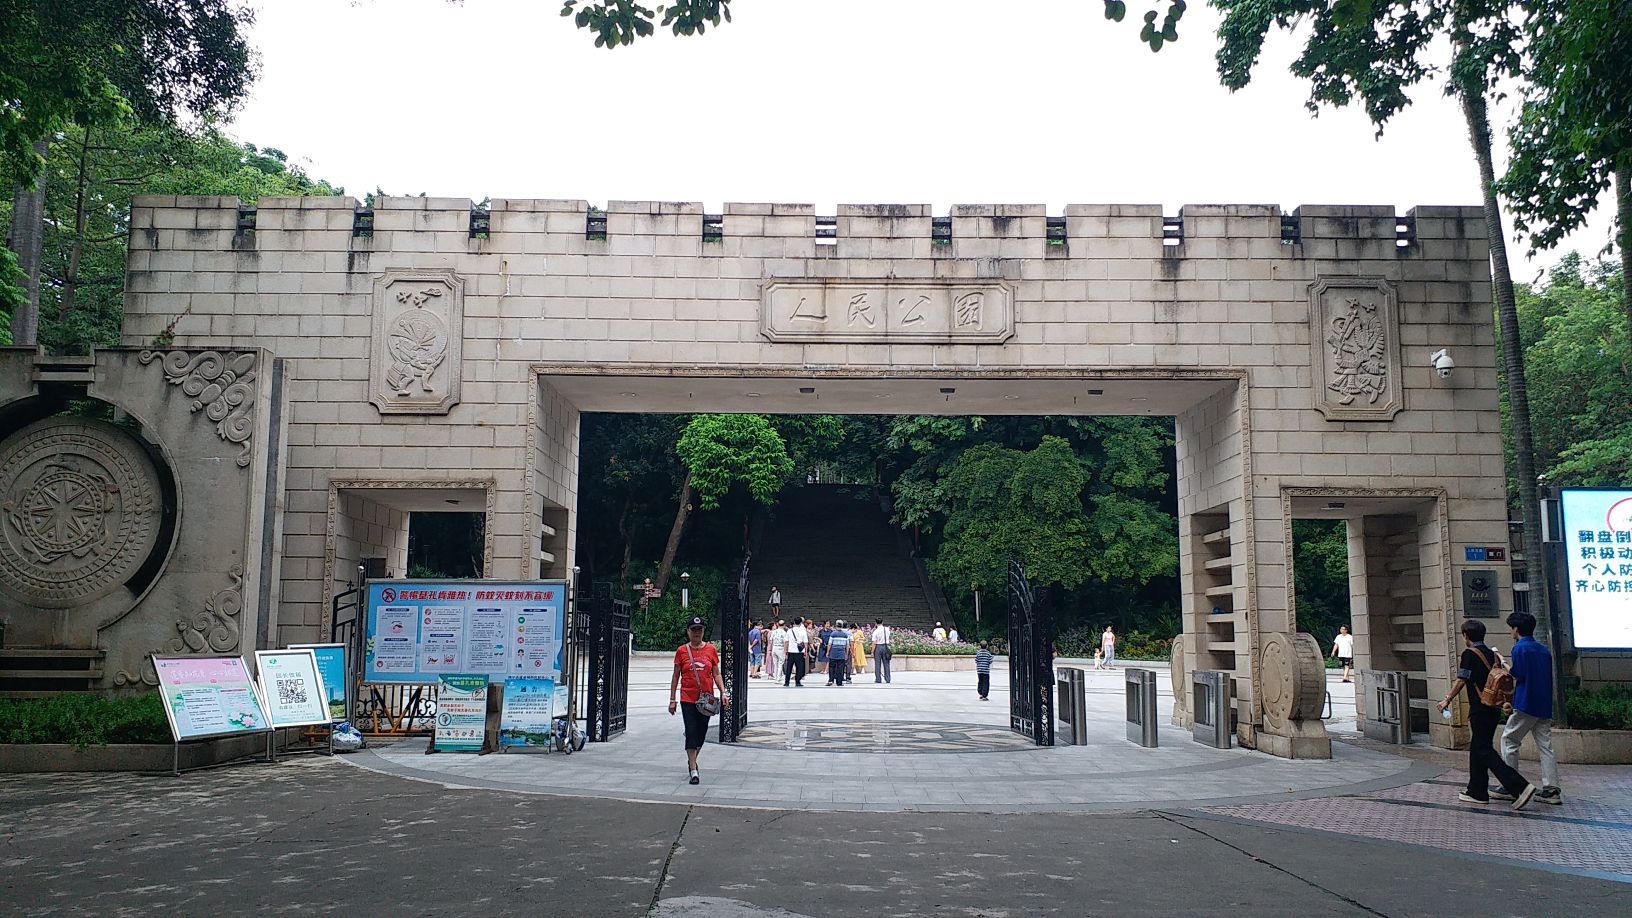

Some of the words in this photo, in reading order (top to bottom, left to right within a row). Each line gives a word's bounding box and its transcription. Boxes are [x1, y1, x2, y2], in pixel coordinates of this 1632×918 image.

[1578, 530, 1631, 543] 翻盘倒
[1580, 547, 1632, 559] 积极动
[1582, 563, 1632, 576] 个人防
